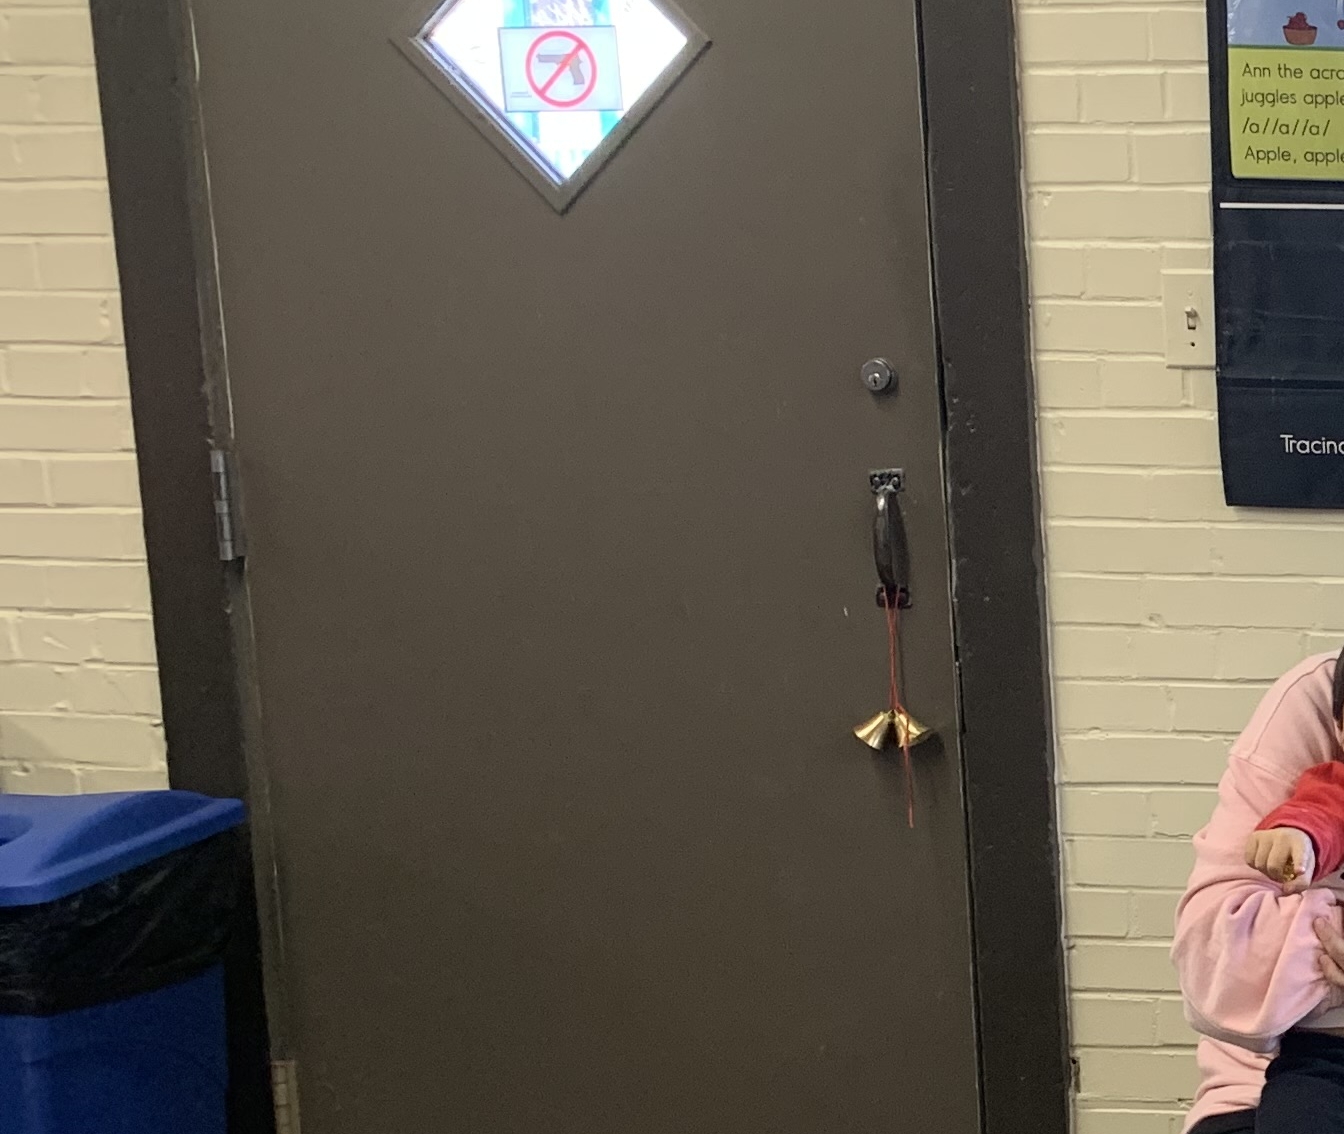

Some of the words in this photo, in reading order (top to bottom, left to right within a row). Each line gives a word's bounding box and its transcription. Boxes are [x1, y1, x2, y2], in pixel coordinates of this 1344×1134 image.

[1242, 63, 1271, 78] Ann
[1278, 63, 1303, 79] the
[1240, 88, 1297, 107] juggles
[1244, 146, 1297, 164] Apple,
